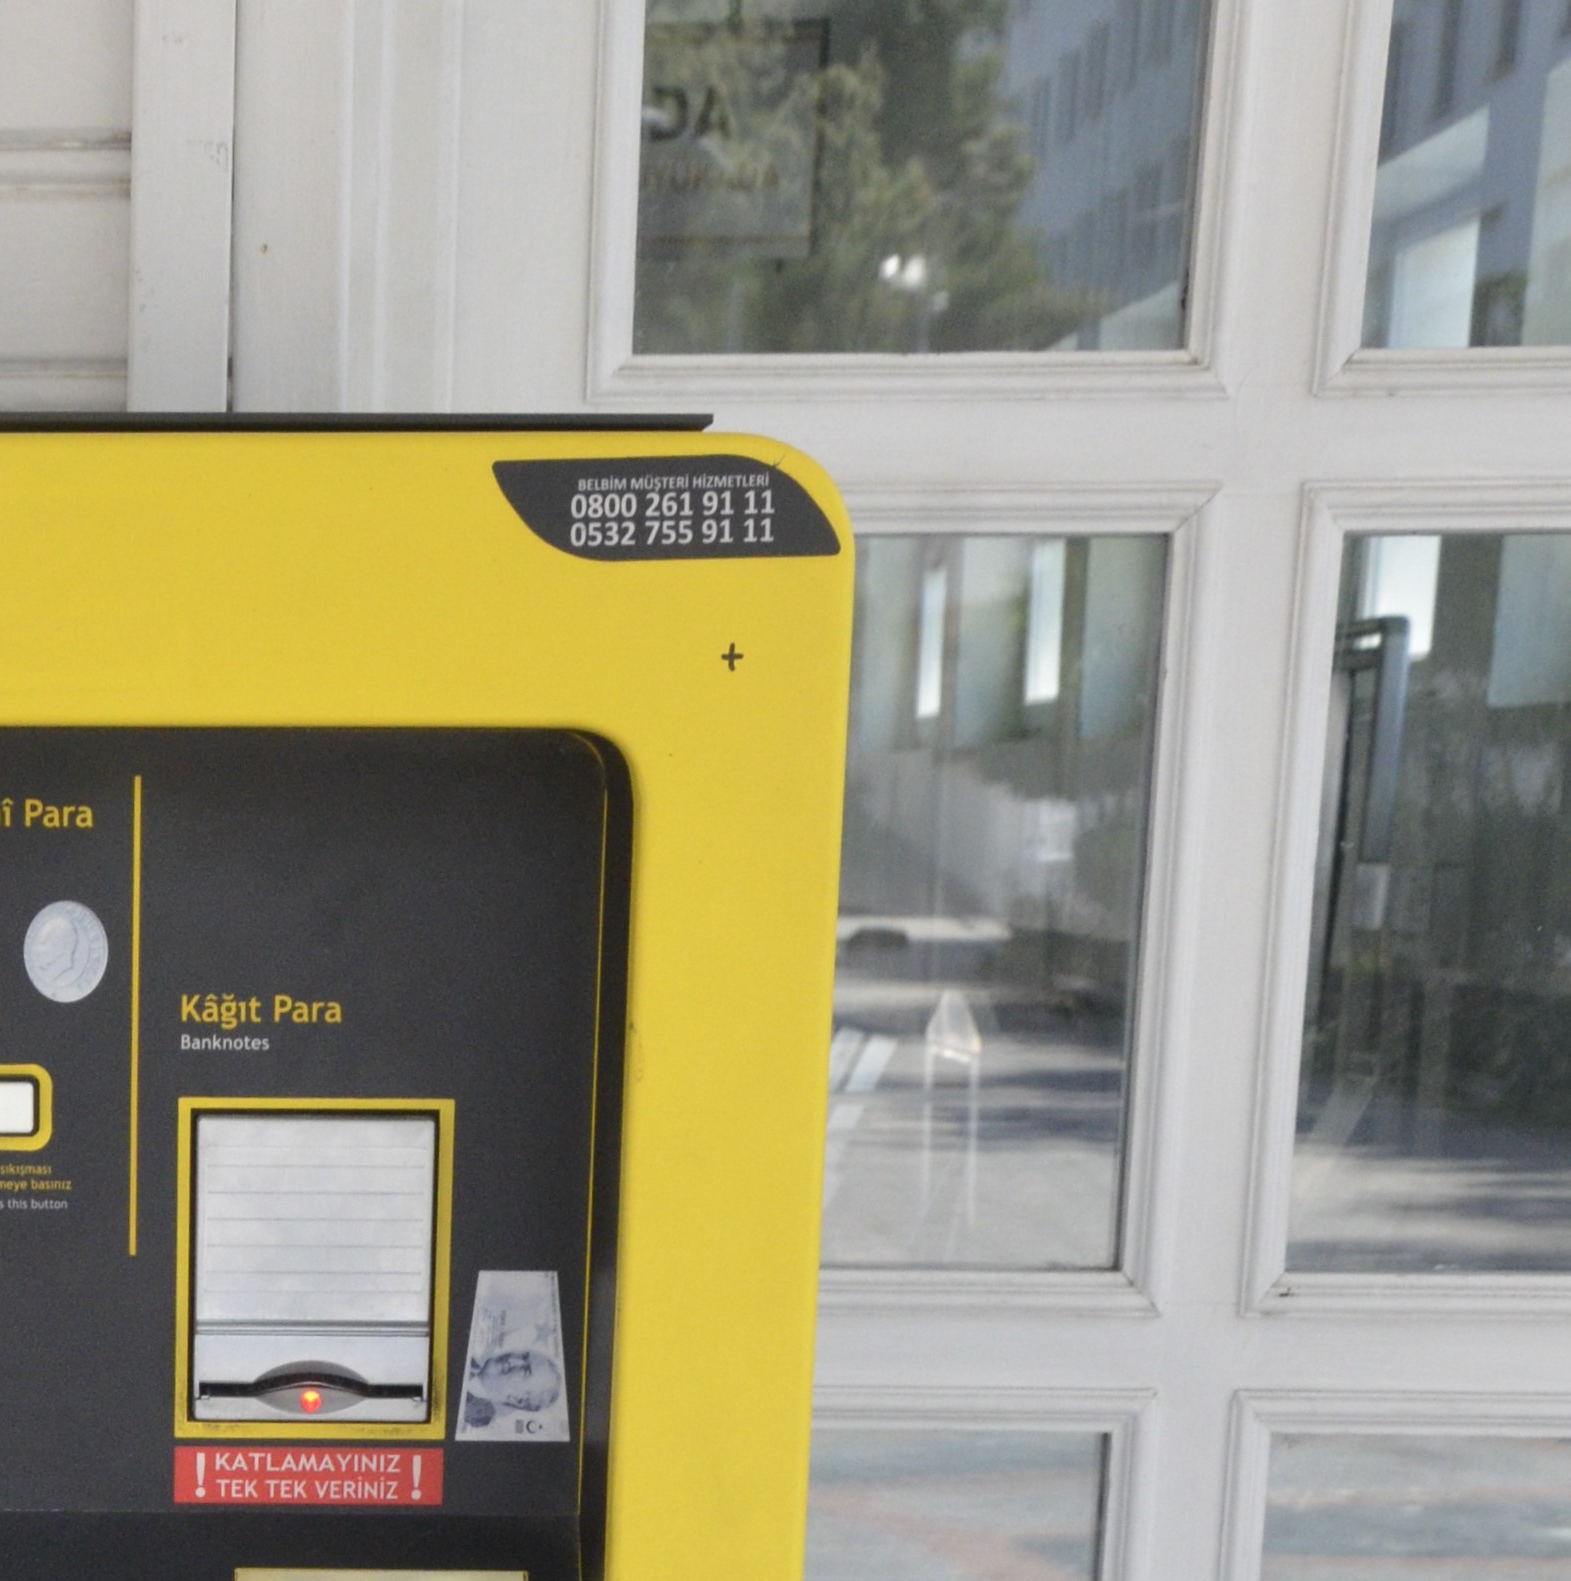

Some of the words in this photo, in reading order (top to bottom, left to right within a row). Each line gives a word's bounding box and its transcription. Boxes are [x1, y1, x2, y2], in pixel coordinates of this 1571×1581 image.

[577, 475, 628, 492] BELBİM
[629, 472, 690, 493] MÜŞTERİ
[691, 471, 770, 489] HİZMETLERİ
[570, 492, 638, 520] 0800
[644, 491, 694, 518] 261
[701, 490, 735, 516] 91
[743, 489, 776, 515] 11
[570, 520, 637, 547] 0532
[644, 520, 694, 545] 755
[701, 518, 734, 544] 91
[742, 518, 776, 543] 11
[24, 798, 94, 829] Para
[181, 993, 262, 1030] Kâğıt
[274, 994, 343, 1024] Para
[180, 1033, 271, 1051] Banknotes
[0, 1163, 53, 1176] sıkışması
[30, 1178, 72, 1191] basınız
[7, 1198, 29, 1210] this
[30, 1198, 69, 1210] button
[215, 1452, 401, 1473] KATLAMAYINIZ
[216, 1478, 259, 1498] TEK
[265, 1479, 308, 1499] TEK
[315, 1476, 399, 1499] VERİNİZ
